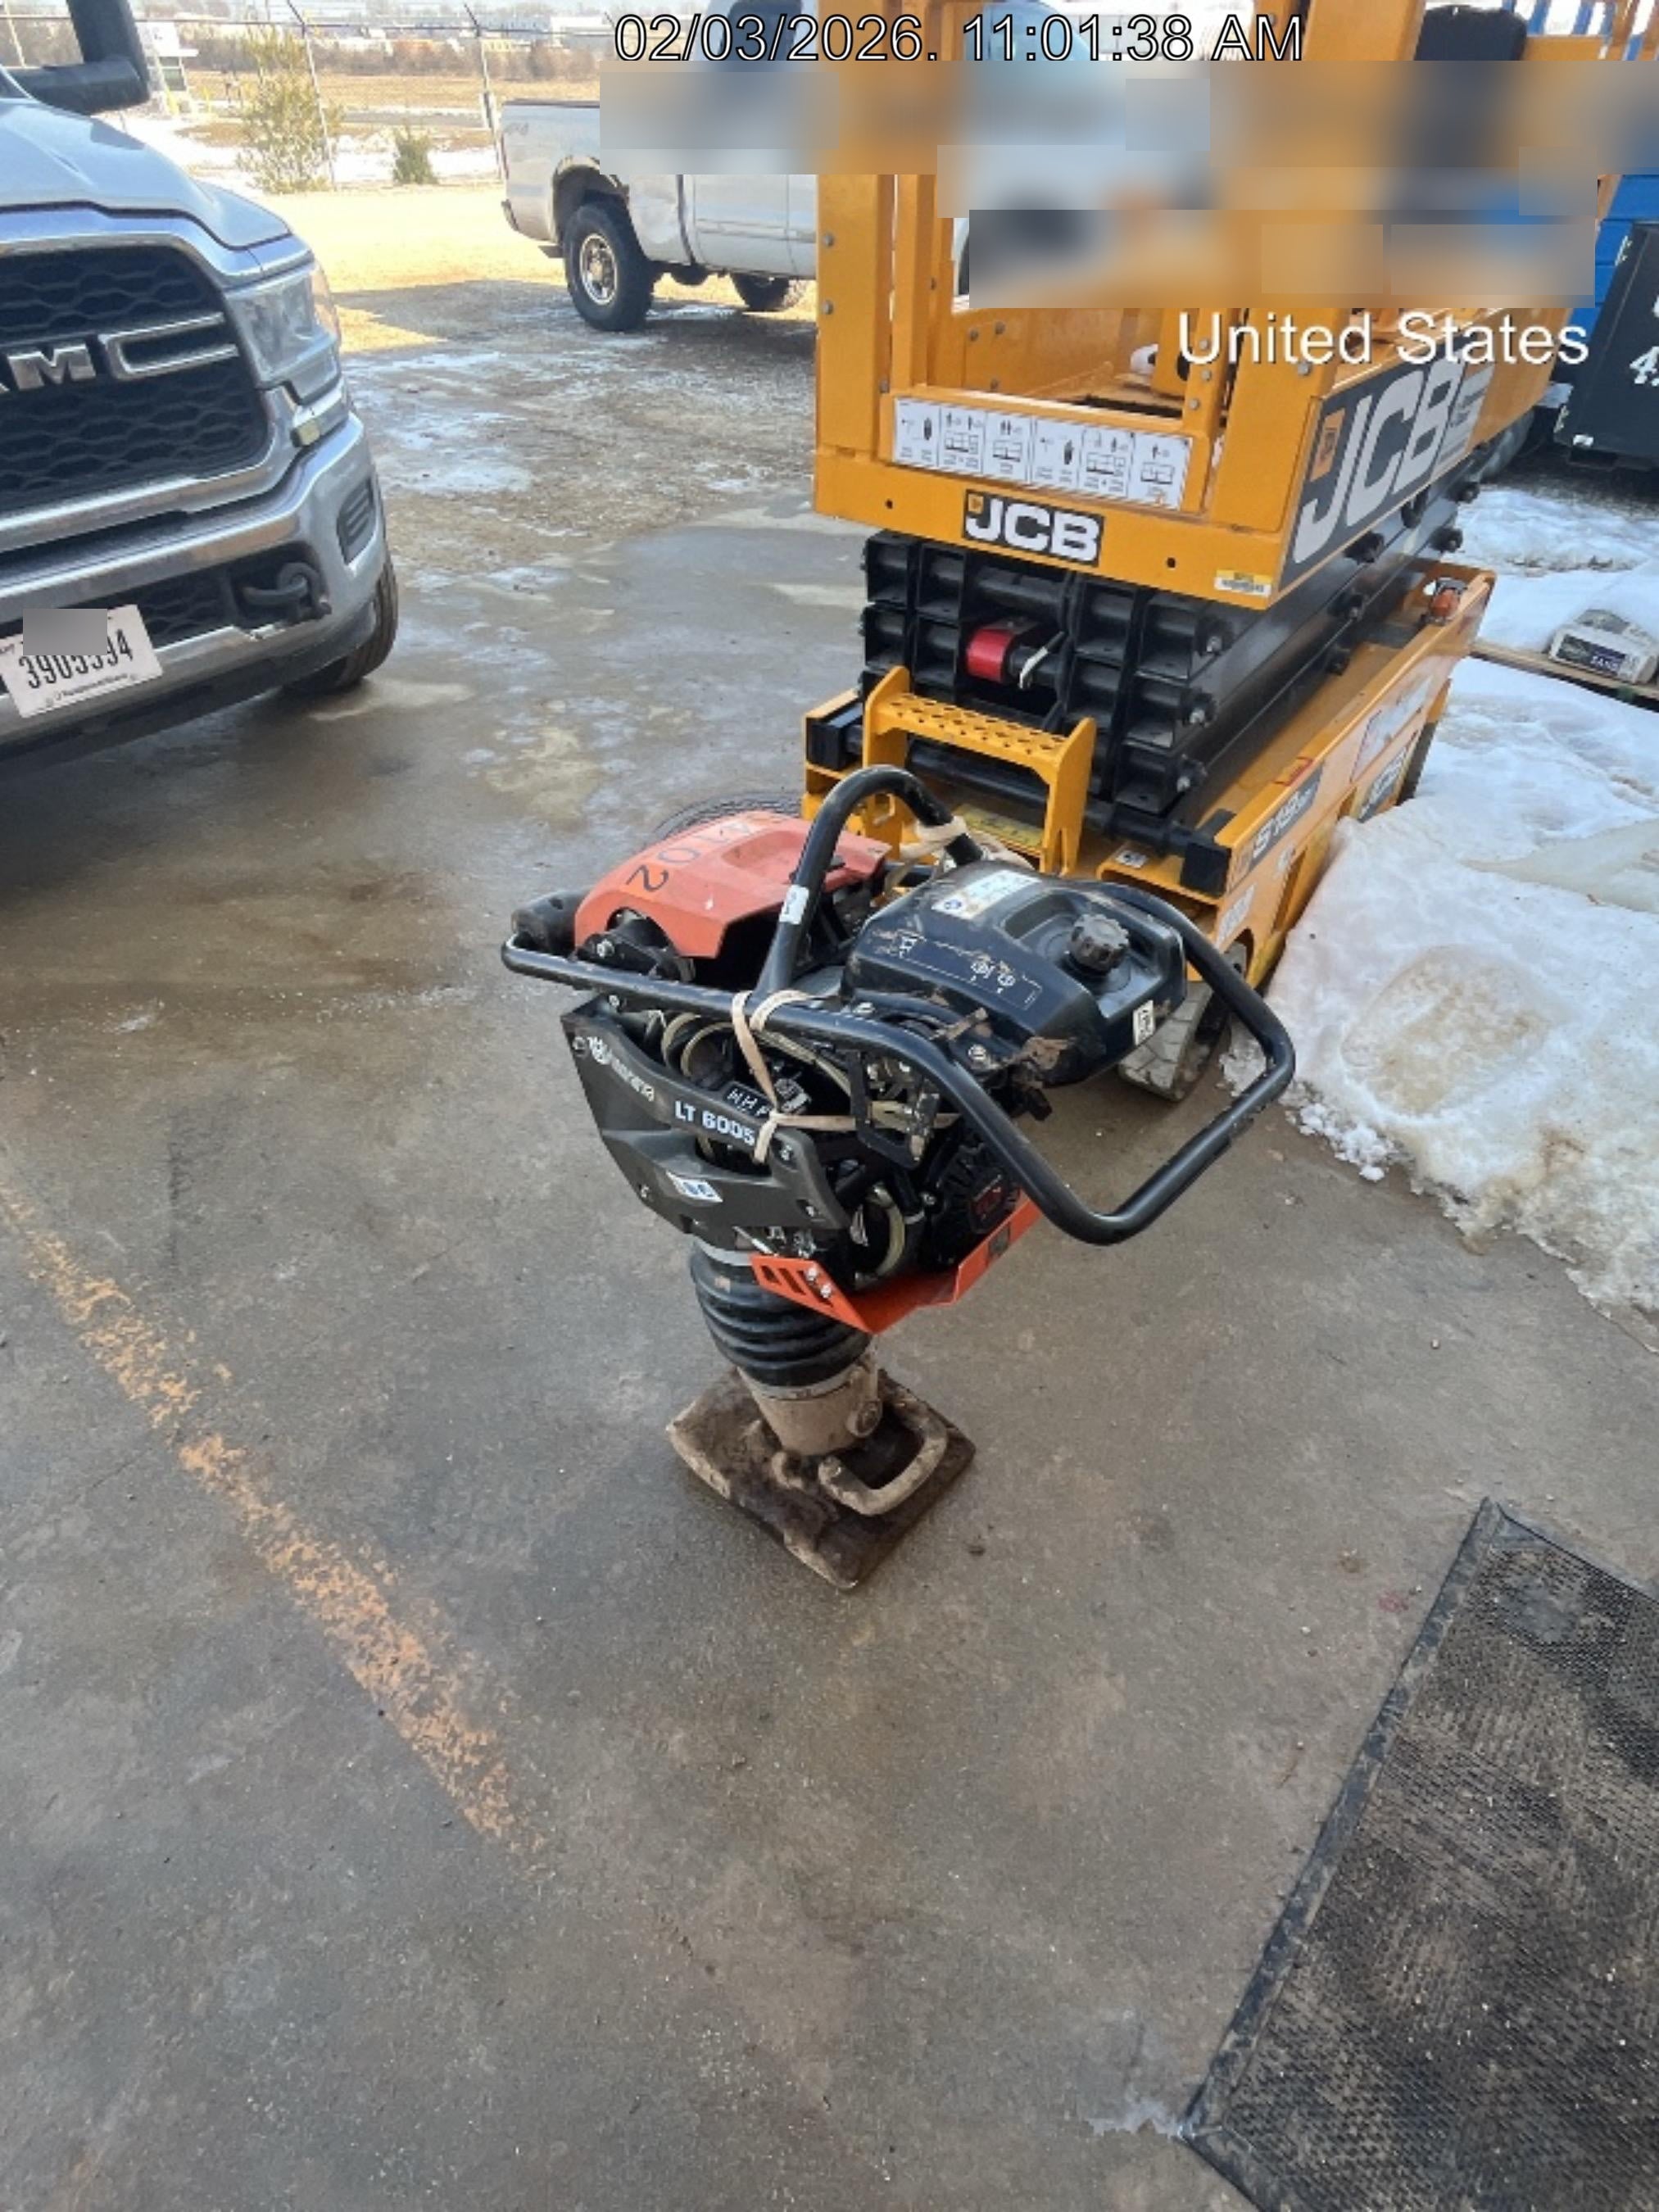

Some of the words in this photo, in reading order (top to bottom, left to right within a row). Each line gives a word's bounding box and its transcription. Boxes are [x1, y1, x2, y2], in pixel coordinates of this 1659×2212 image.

[1293, 351, 1466, 564] JCB
[966, 498, 1099, 561] JCB
[675, 1100, 696, 1122] LT
[702, 1110, 755, 1146] 6005
